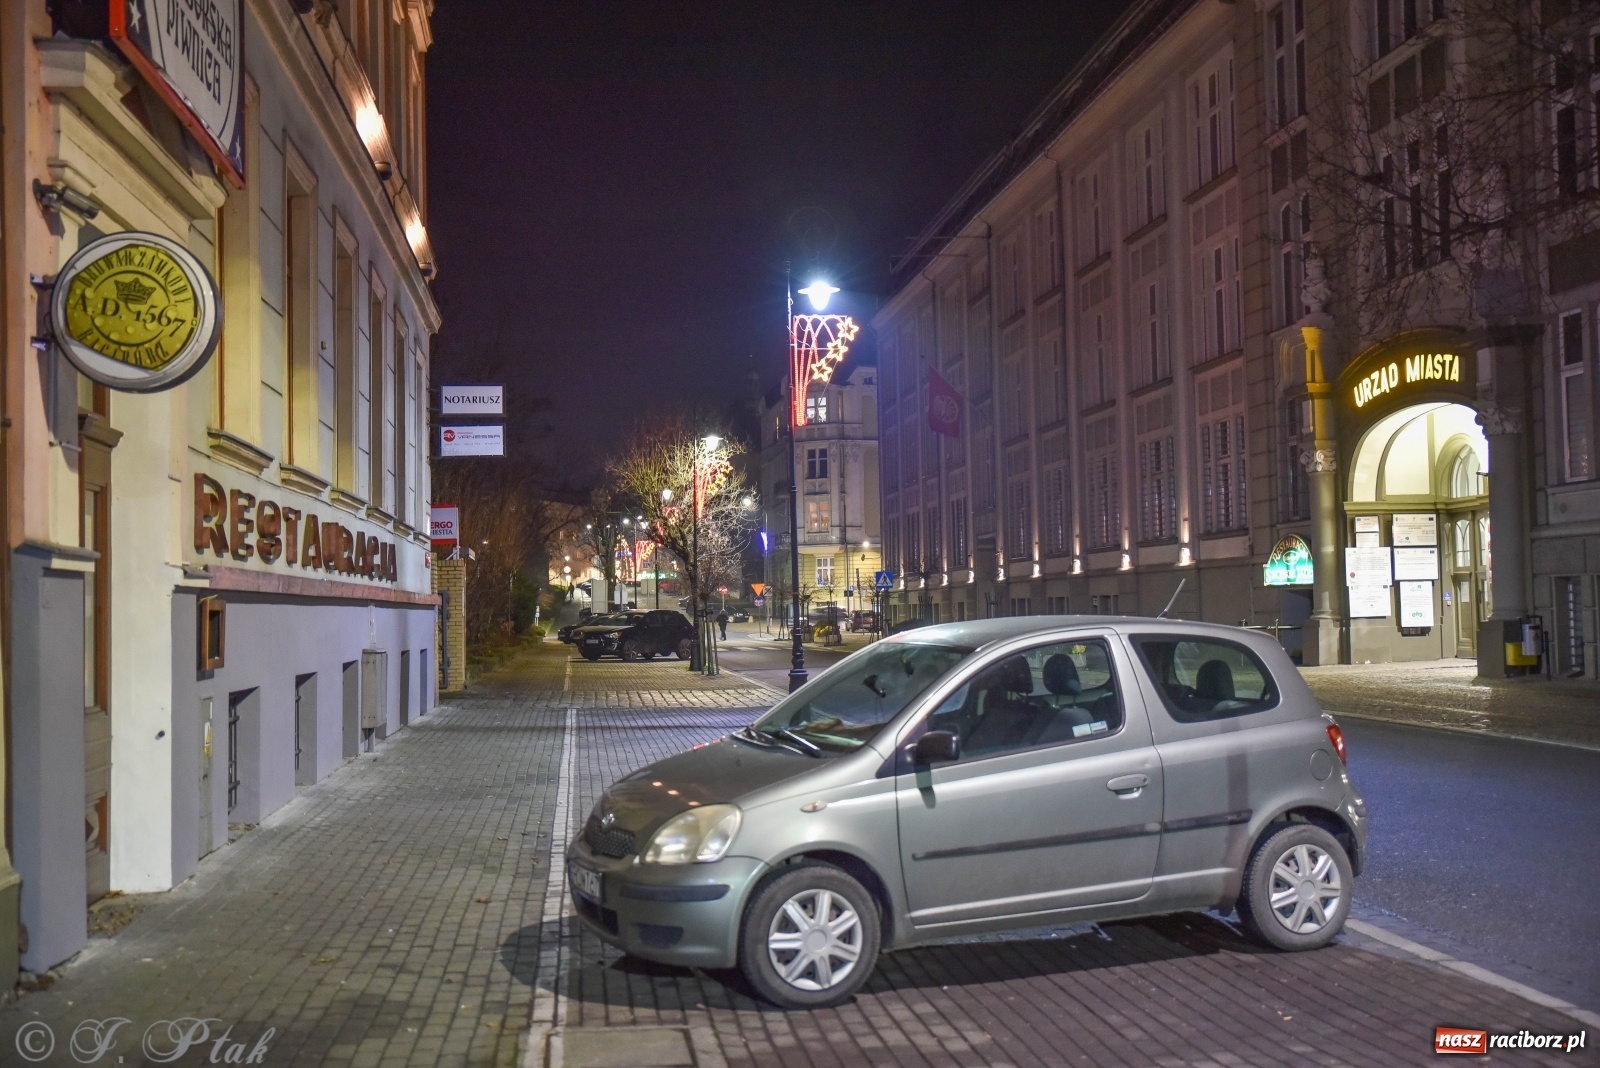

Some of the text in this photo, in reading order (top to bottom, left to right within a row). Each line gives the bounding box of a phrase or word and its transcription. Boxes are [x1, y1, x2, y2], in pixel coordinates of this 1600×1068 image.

[134, 304, 186, 338] 1567
[1353, 353, 1460, 408] URZĄD MIASTA
[444, 395, 501, 404] NOTARIUSZ
[193, 472, 398, 583] RESTAURACJA
[431, 521, 454, 529] ERGO
